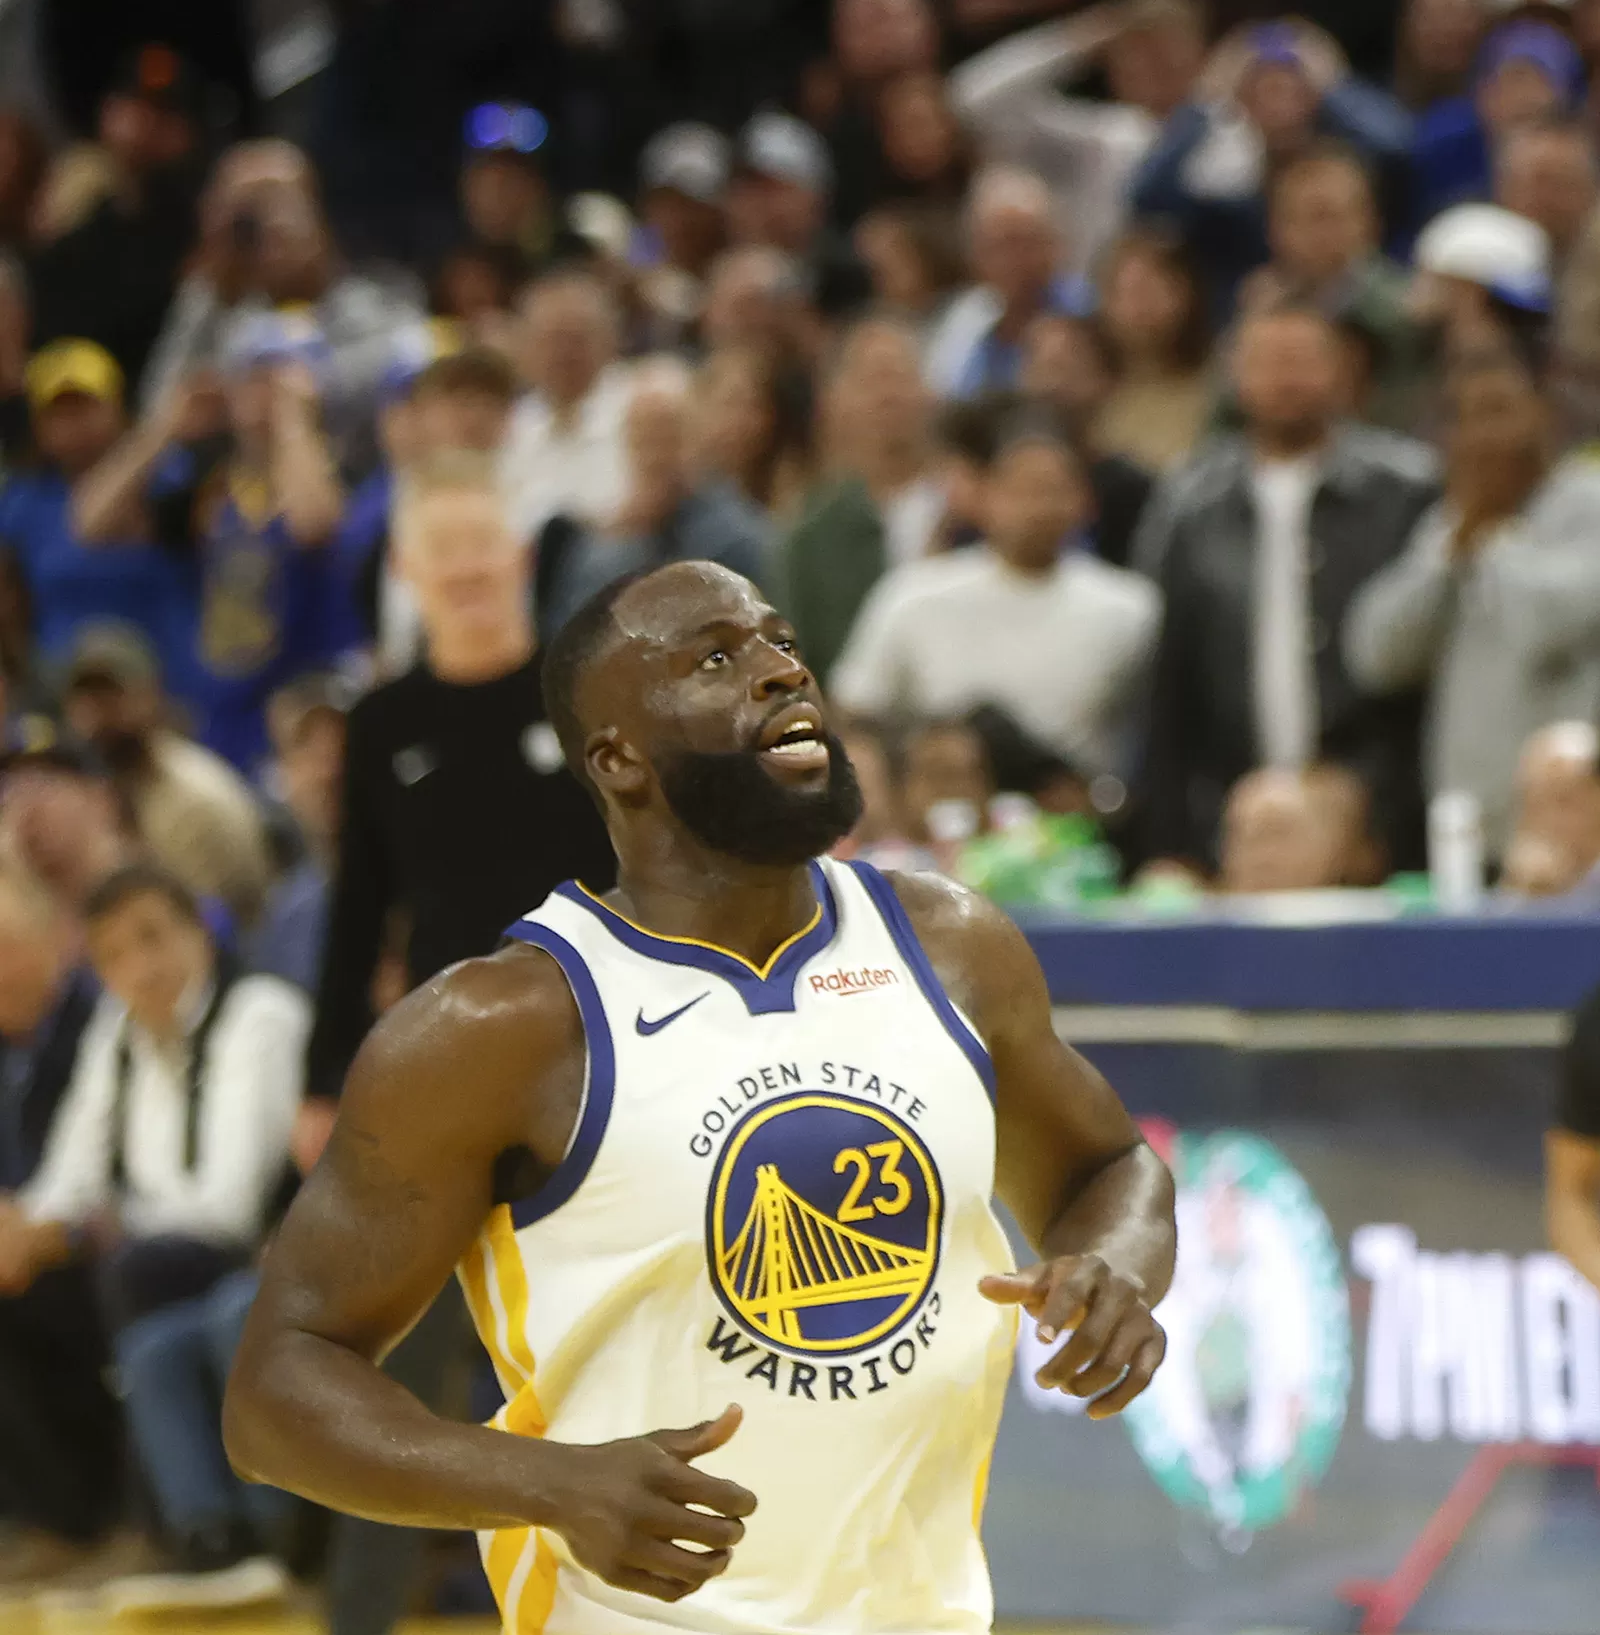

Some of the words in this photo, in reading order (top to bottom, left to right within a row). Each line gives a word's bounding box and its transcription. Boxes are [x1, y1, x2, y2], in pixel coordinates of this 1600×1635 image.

[808, 966, 899, 995] Rakuten
[690, 1062, 802, 1160] GOLDEN
[821, 1062, 927, 1123] STATE
[833, 1139, 912, 1224] 23
